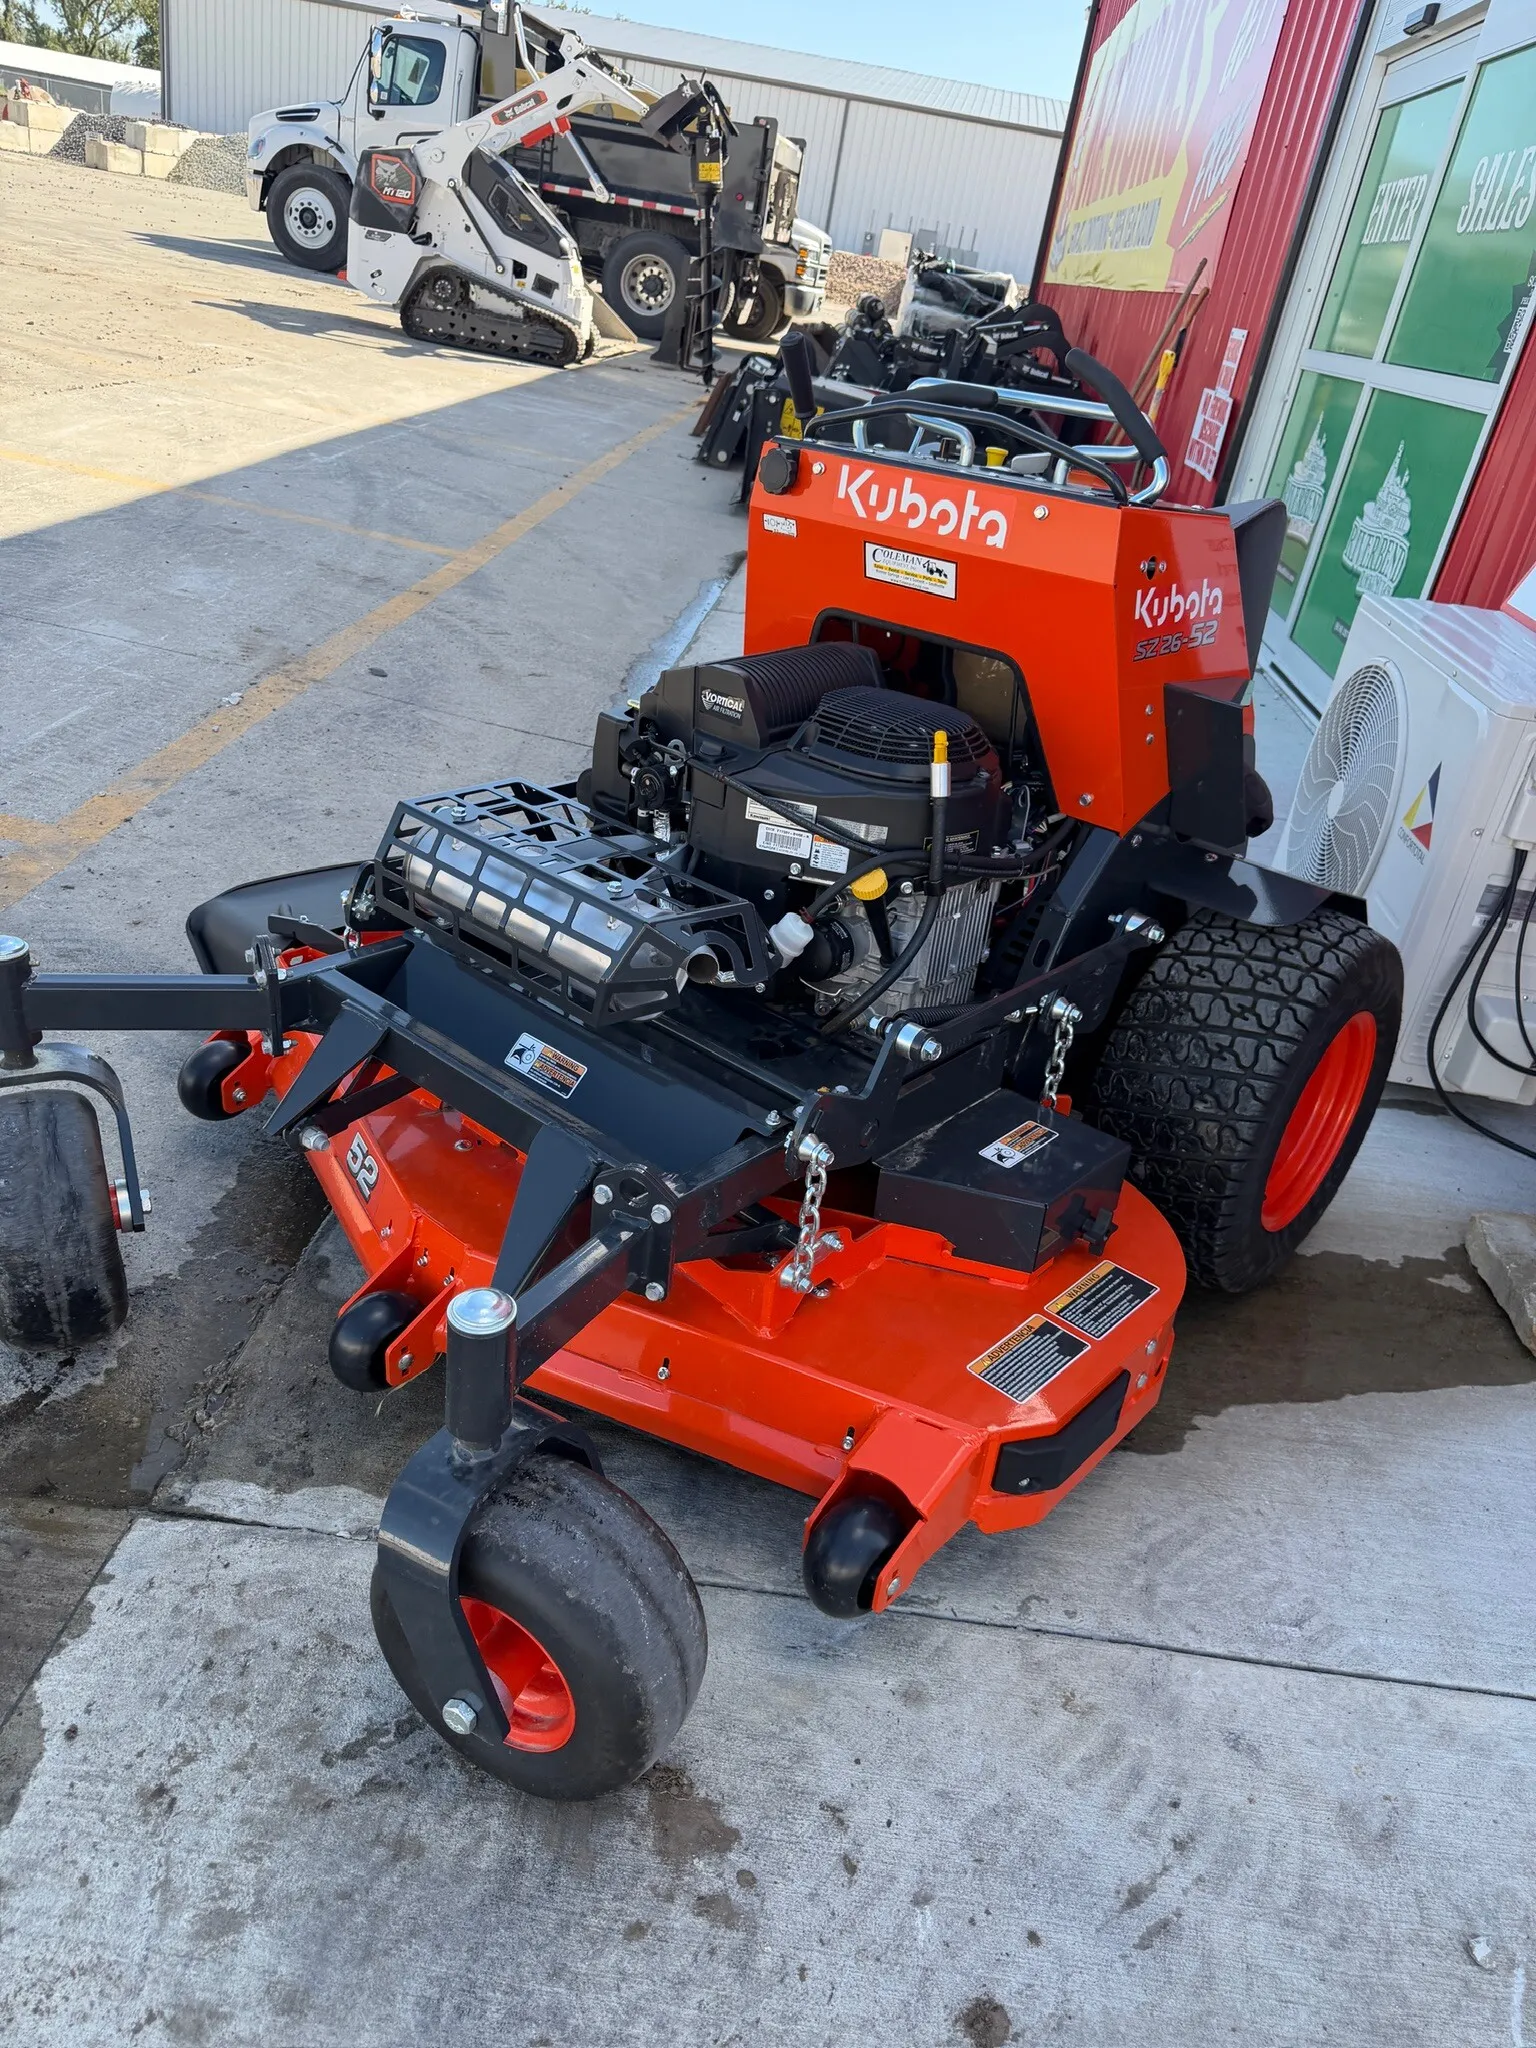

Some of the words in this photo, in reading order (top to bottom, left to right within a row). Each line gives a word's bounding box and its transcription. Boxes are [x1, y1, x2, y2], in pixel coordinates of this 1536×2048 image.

[1182, 82, 1259, 228] FREE
[1361, 174, 1428, 245] ENTER
[837, 464, 1008, 550] Kubota
[872, 548, 923, 566] COLEMAN
[1134, 578, 1223, 629] Kubota
[705, 691, 743, 712] VORTICAL
[712, 705, 720, 713] AIR
[720, 708, 742, 720] FILTRATION
[539, 1063, 577, 1086] ADVERTENCIA
[552, 1050, 580, 1072] WARNING
[346, 1131, 379, 1203] 52
[1066, 1273, 1101, 1299] WARNING
[987, 1324, 1036, 1363] ADVERTENCIA
